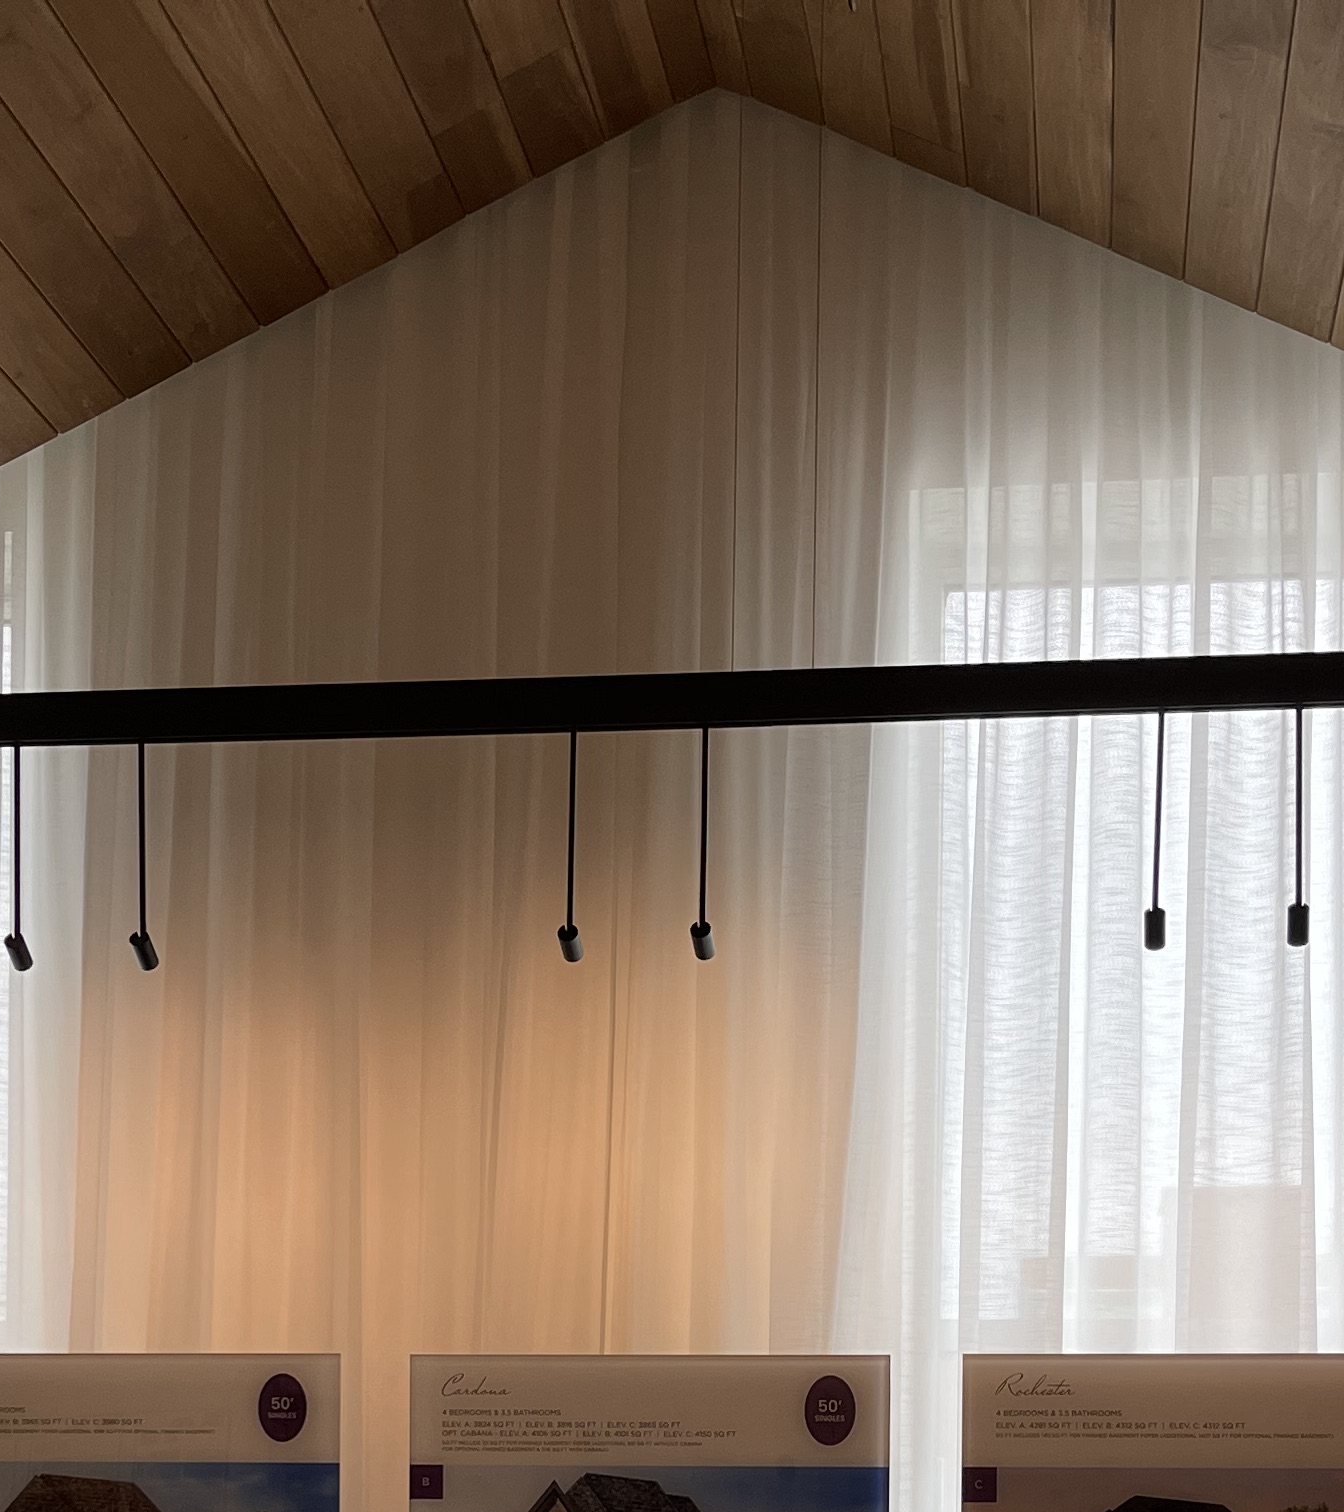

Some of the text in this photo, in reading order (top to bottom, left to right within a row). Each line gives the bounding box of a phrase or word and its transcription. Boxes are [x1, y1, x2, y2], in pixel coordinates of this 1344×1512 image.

[441, 1372, 511, 1397] Cardona
[995, 1372, 1075, 1397] Rochester
[1003, 1409, 1048, 1417] BEDROOMS
[1071, 1409, 1123, 1417] BATHROOMS
